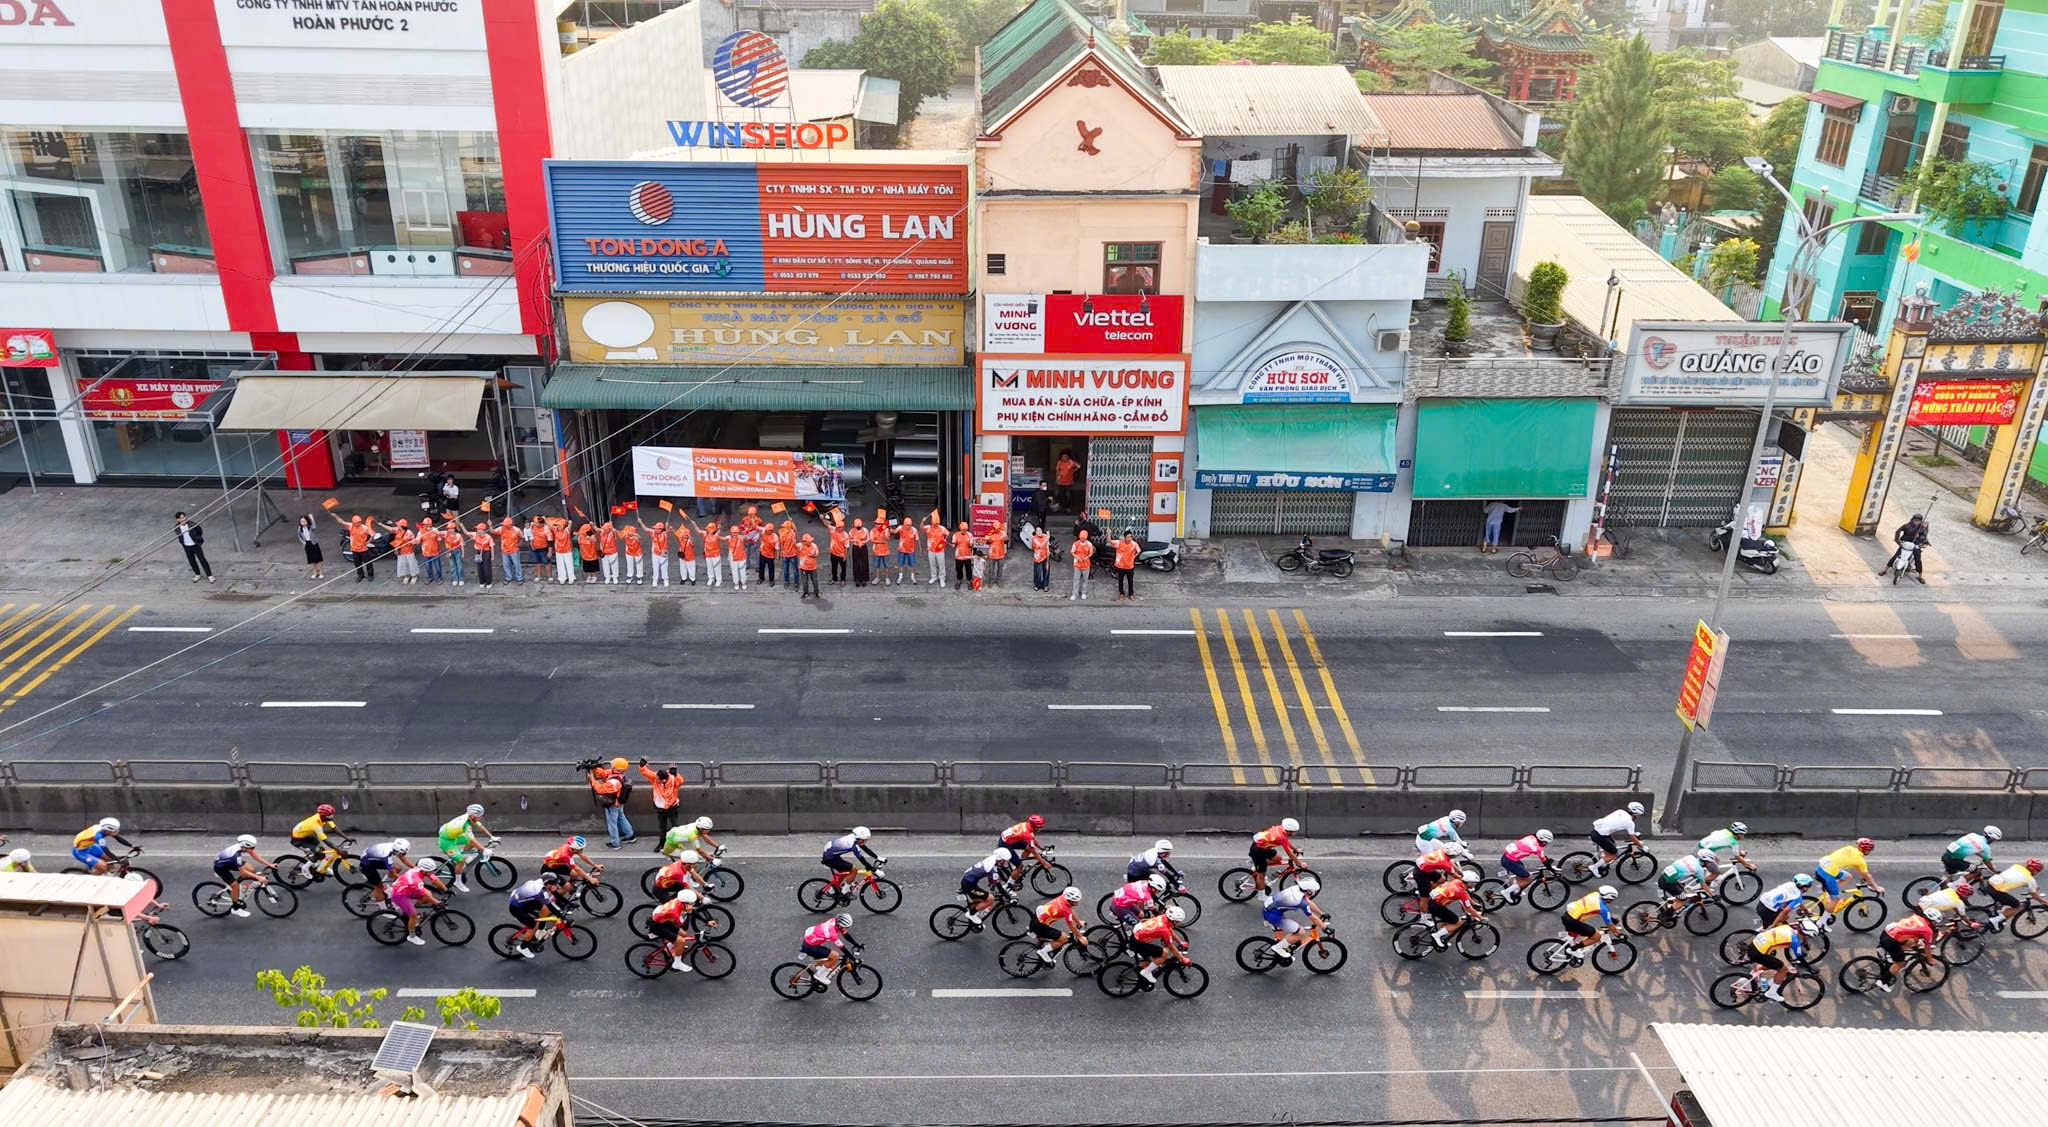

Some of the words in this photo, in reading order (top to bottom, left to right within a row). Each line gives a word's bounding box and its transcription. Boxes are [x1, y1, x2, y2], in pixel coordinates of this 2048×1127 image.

[275, 0, 289, 9] TY
[292, 0, 323, 10] TNHH
[326, 0, 349, 10] MTV
[293, 16, 336, 30] HOÀN
[340, 15, 394, 31] PHƯỚC
[400, 19, 409, 31] 2
[666, 120, 850, 149] WINSHOP
[765, 184, 786, 194] CTY
[790, 184, 817, 194] TNHH
[819, 185, 833, 194] SX
[840, 185, 854, 194] TM
[861, 185, 875, 194] DV
[883, 183, 905, 194] NHÀ
[908, 183, 929, 195] MÁY
[933, 183, 954, 195] TÔN
[767, 205, 866, 239] HÙNG
[882, 214, 954, 239] LAN
[585, 238, 636, 256] TON
[640, 238, 708, 257] DONG
[712, 238, 729, 257] A
[586, 261, 631, 274] THƯƠNG
[633, 262, 657, 275] HIỆU
[659, 259, 689, 274] QUỐC
[691, 263, 710, 274] GIA
[703, 309, 744, 322] NHÀ
[751, 311, 789, 322] MÁY
[999, 310, 1031, 318] MINH
[1073, 309, 1154, 327] viettel
[995, 321, 1037, 330] VƯƠNG
[671, 322, 821, 345] HÙNG
[844, 329, 955, 346] LAN
[1104, 330, 1153, 341] telecom
[1681, 348, 1767, 374] QUẢNG
[1026, 370, 1085, 389] MINH
[1091, 369, 1175, 389] VƯƠNG
[1266, 370, 1297, 384] HỮU
[1300, 371, 1329, 384] SƠN
[136, 384, 149, 392] XE
[150, 383, 168, 392] MÁY
[170, 383, 194, 392] HOÀN
[1002, 397, 1025, 407] MUA
[1029, 395, 1052, 407] BÁN
[1059, 394, 1080, 407] SỬA
[1083, 395, 1115, 407] CHỮA
[1122, 395, 1134, 407] ÉP
[1136, 395, 1162, 407] KÍNH
[997, 412, 1019, 423] PHỤ
[1021, 411, 1045, 423] KIỆN
[1047, 410, 1082, 422] CHÍNH
[695, 455, 717, 463] CÔNG
[728, 457, 747, 465] TNHH
[696, 466, 749, 483] HÙNG
[756, 471, 789, 484] LAN
[1236, 474, 1251, 483] MTV
[1256, 473, 1301, 487] HỮU
[1753, 478, 1777, 486] AZER
